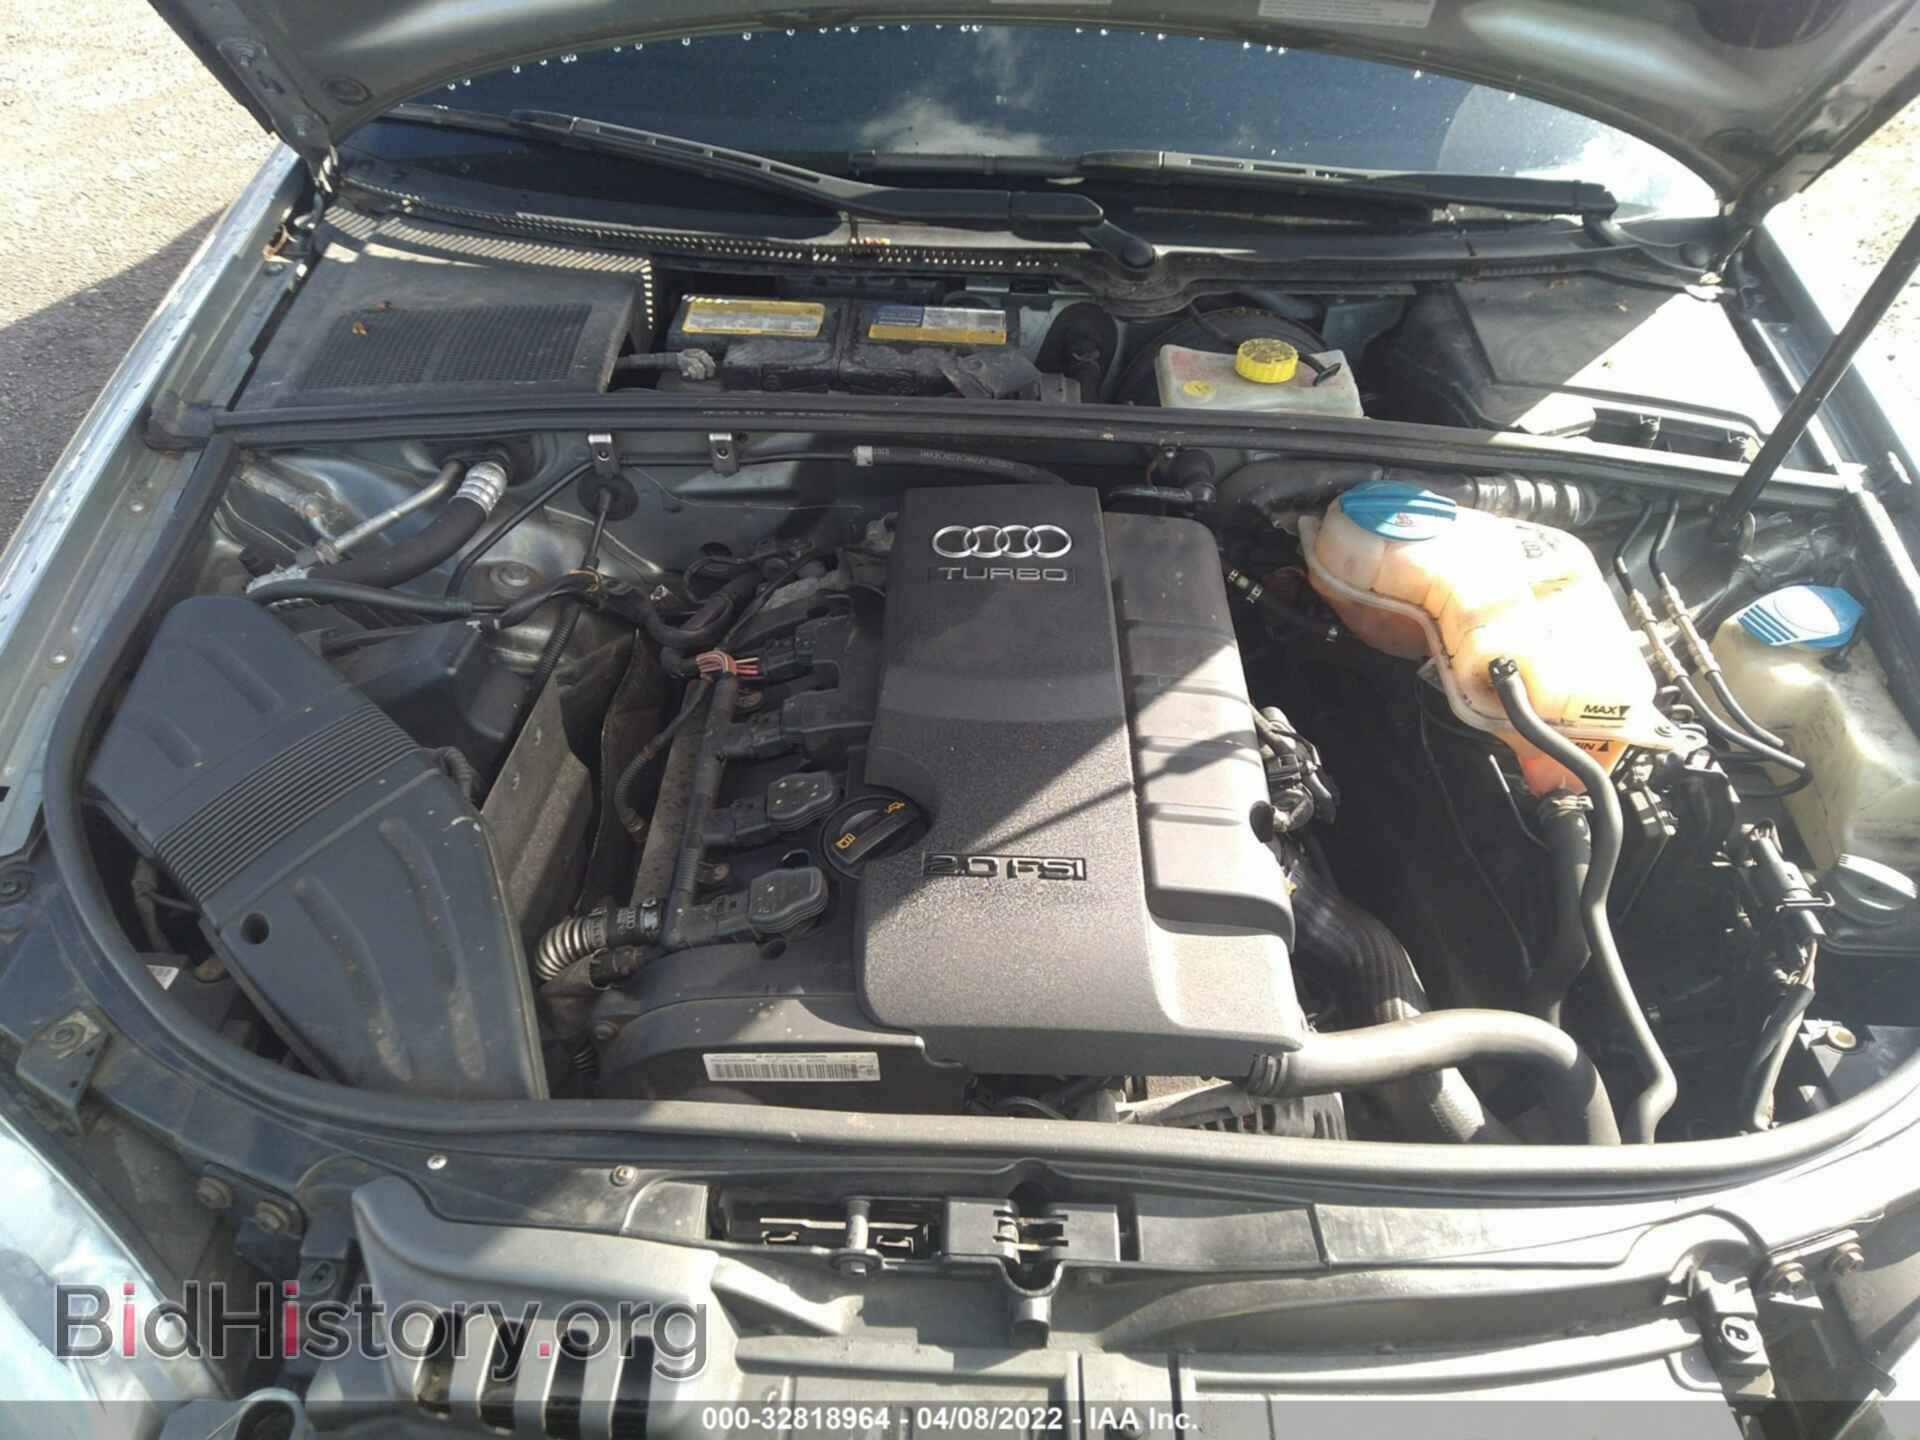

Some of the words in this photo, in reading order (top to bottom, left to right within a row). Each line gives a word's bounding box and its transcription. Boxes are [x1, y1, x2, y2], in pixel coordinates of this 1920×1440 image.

[938, 567, 1068, 582] TURBO
[1583, 704, 1617, 714] MAX
[927, 854, 999, 878] 2.0
[1006, 857, 1086, 881] FSI
